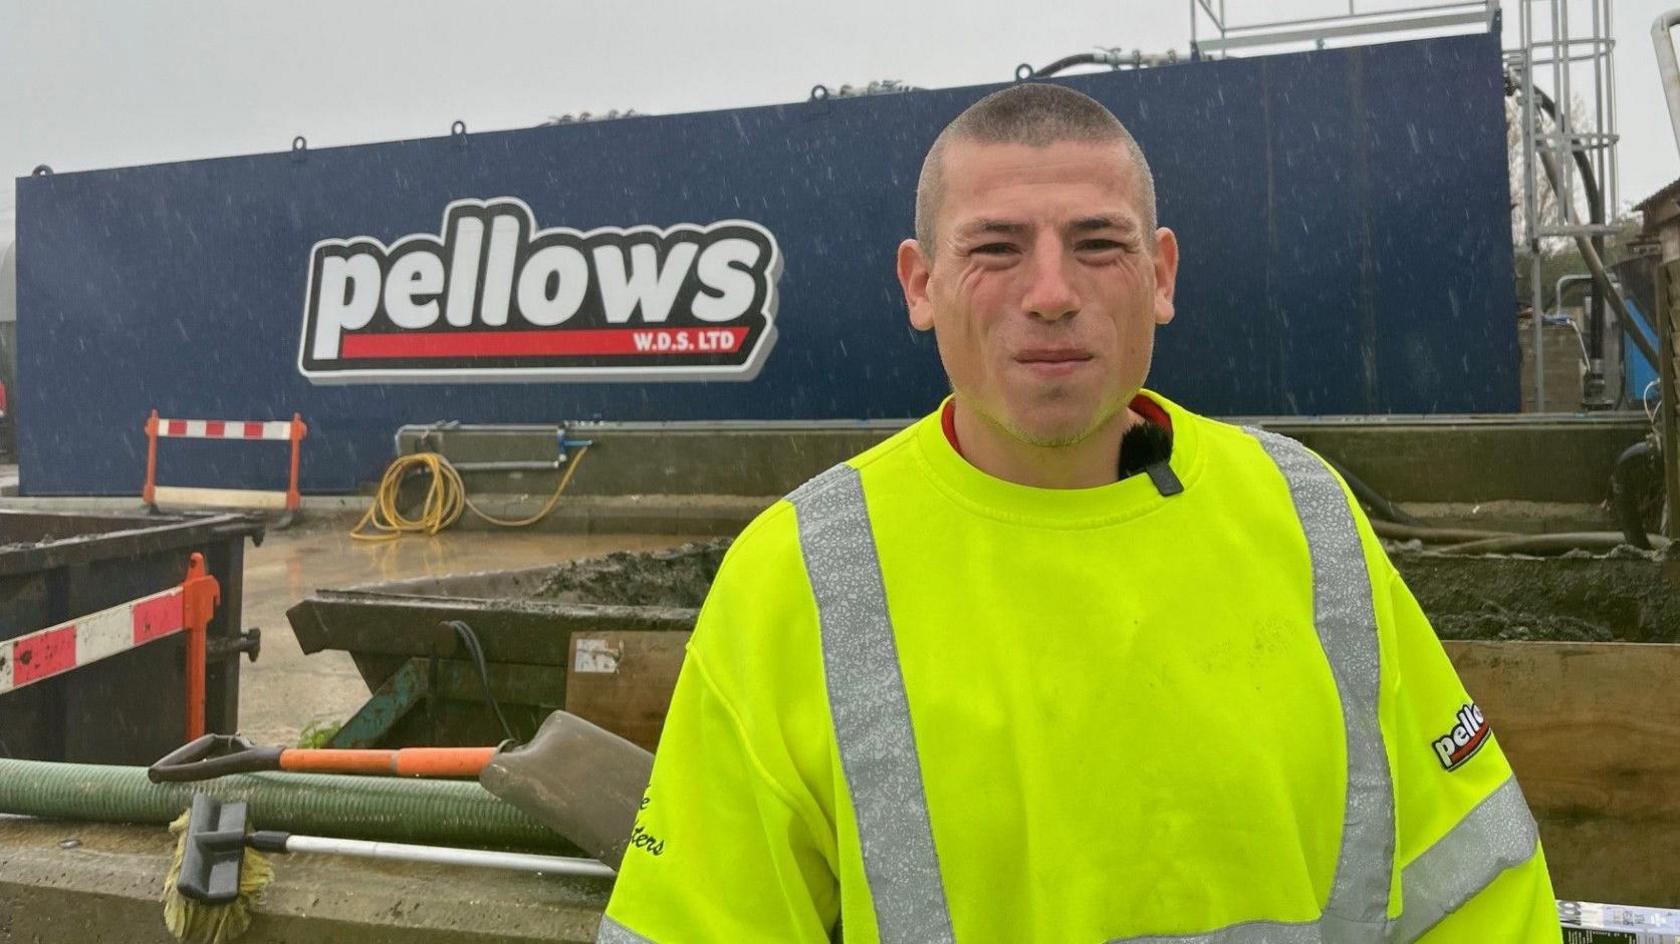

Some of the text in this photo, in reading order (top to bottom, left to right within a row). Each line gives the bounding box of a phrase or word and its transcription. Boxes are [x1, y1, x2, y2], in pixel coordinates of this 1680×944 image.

[312, 215, 759, 360] pellows
[633, 331, 735, 351] W.D.S. LTD
